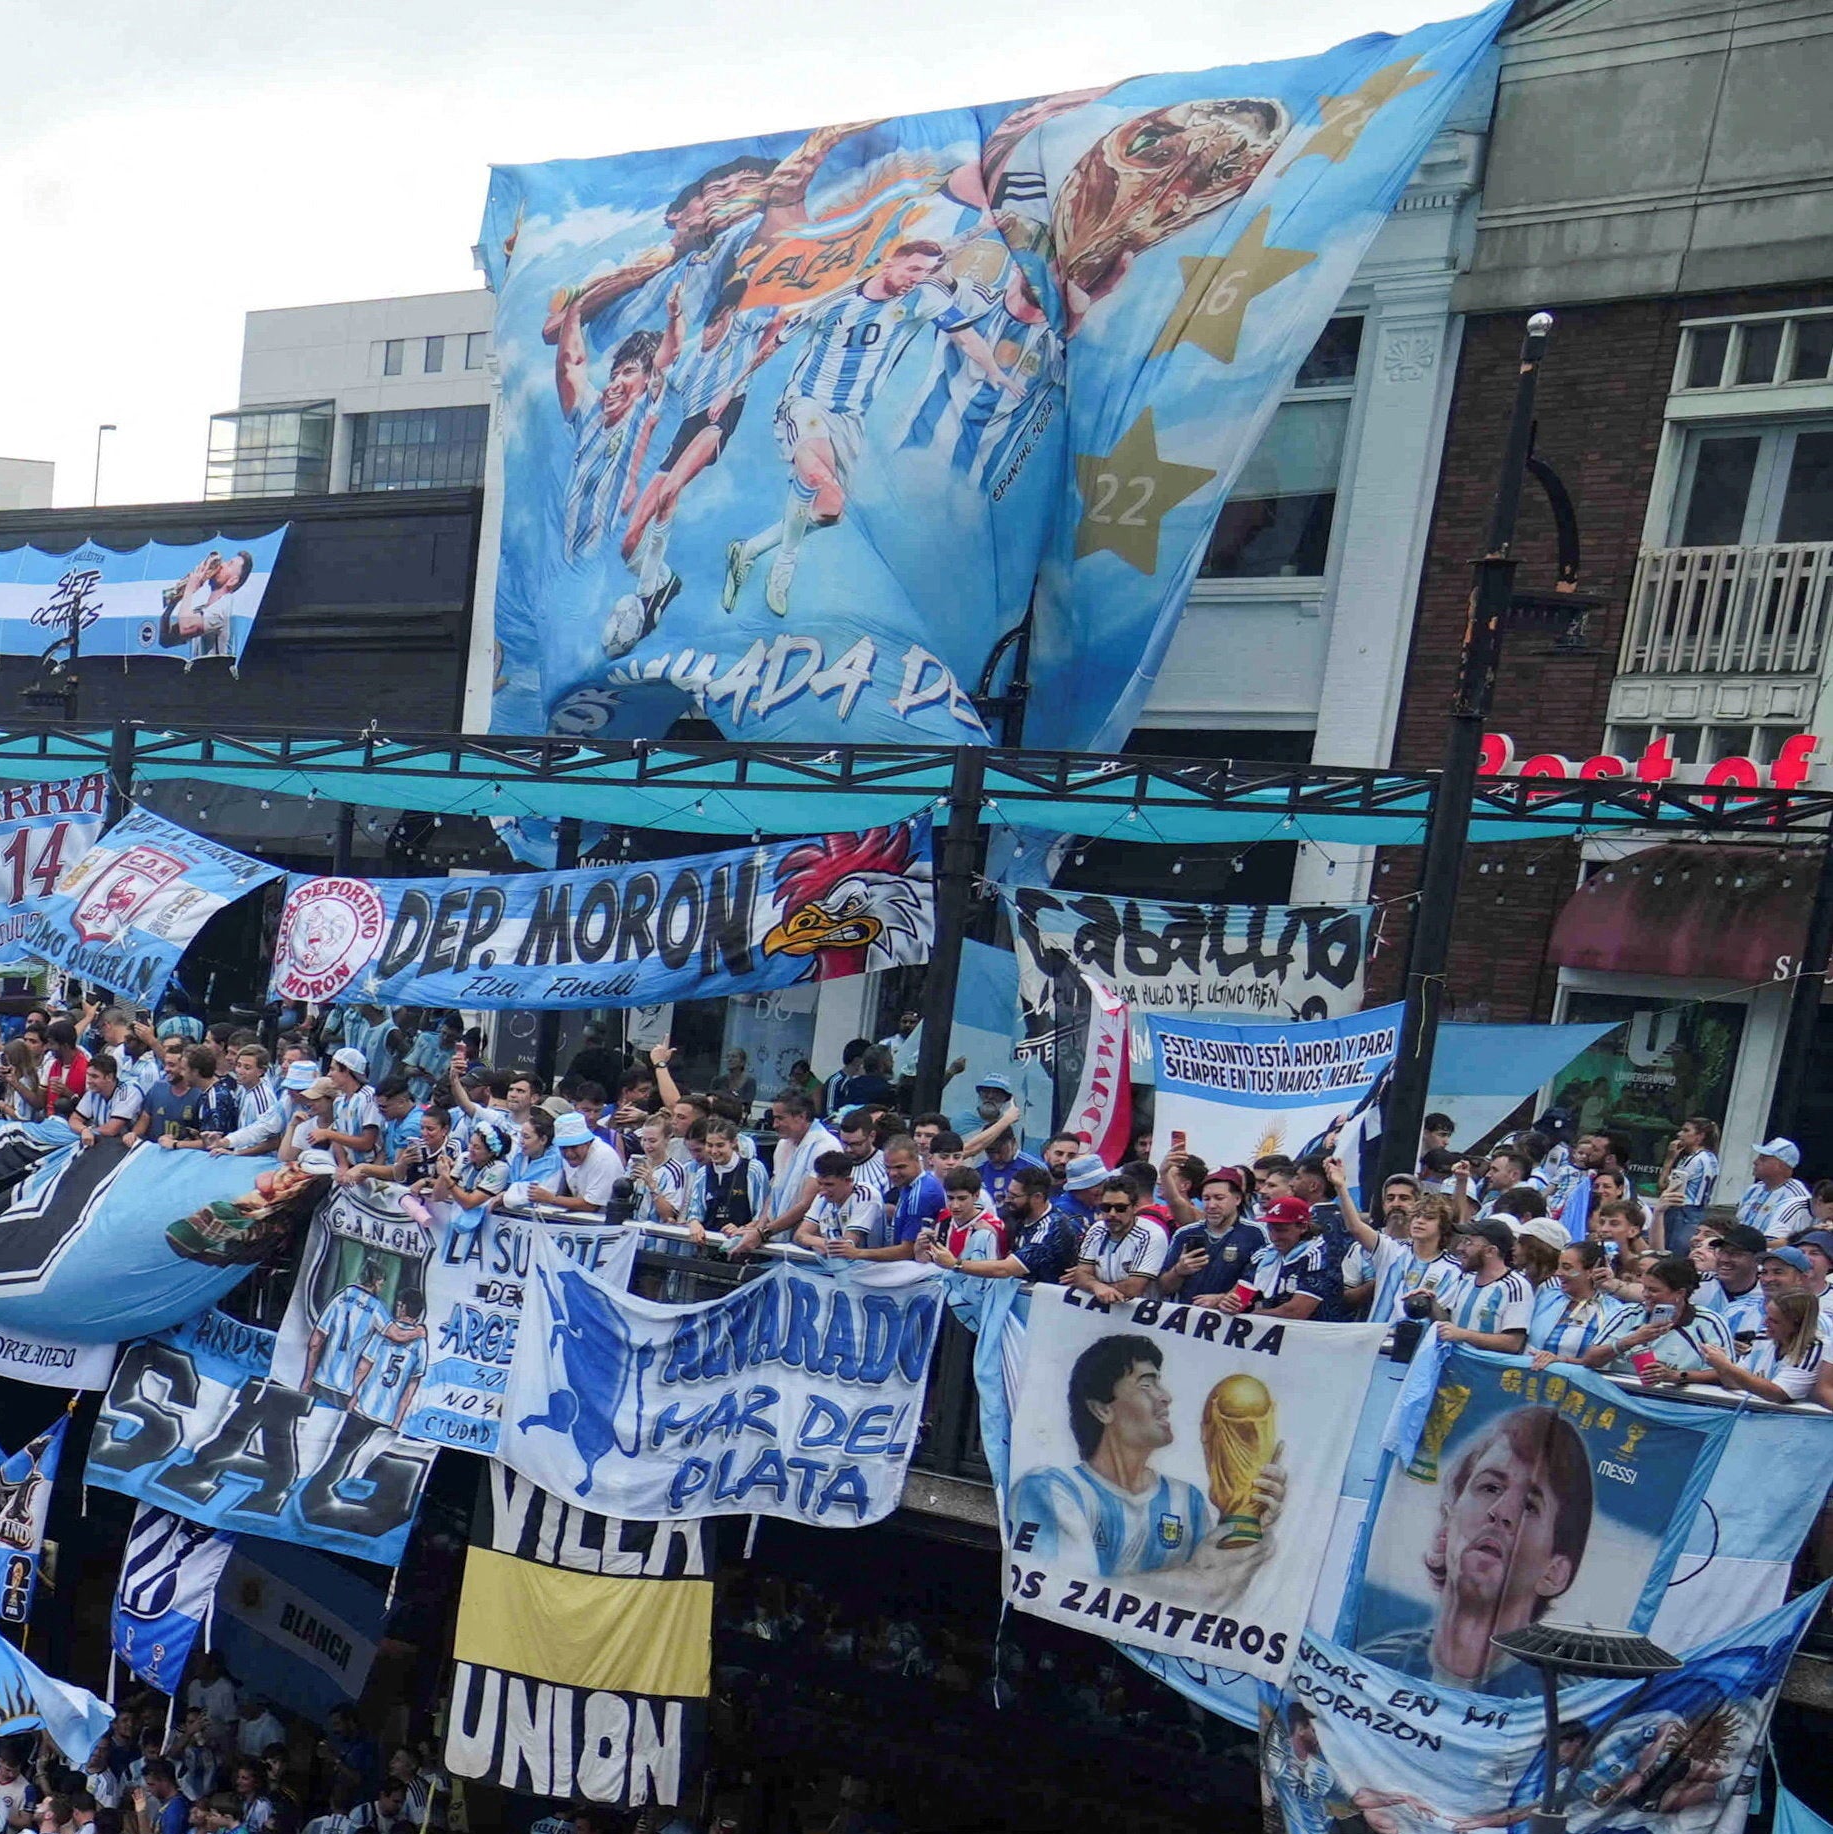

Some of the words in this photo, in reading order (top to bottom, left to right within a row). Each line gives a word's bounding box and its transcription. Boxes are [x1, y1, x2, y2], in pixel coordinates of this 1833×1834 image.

[1091, 470, 1155, 528] 22
[30, 602, 104, 631] OCTAOS
[1, 822, 70, 907] 14
[296, 877, 381, 941] DEPORTIVO
[376, 884, 507, 980] DEP.
[519, 858, 760, 976] MORON
[282, 962, 353, 1000] MORON
[1159, 1031, 1196, 1062] ESTE
[1199, 1038, 1254, 1068] ASUNTO
[1256, 1037, 1289, 1069] ESTÁ
[1294, 1039, 1341, 1068] AHORA
[1344, 1035, 1356, 1060] Y
[1357, 1027, 1394, 1056] PARA
[1164, 1058, 1227, 1092] SIEMPRE
[1230, 1064, 1247, 1092] EN
[1249, 1067, 1274, 1094] TUS
[1276, 1067, 1324, 1099] MANOS,
[663, 1275, 933, 1385] ALVARADO
[1131, 1298, 1288, 1358] BARRA
[382, 1353, 405, 1389] 5
[424, 1415, 491, 1445] CIUDAD
[652, 1382, 782, 1449] MAR
[798, 1393, 911, 1457] DEL
[668, 1448, 870, 1522] PLATA
[1596, 1459, 1638, 1486] MESSI
[278, 1604, 354, 1672] BLANCA
[1059, 1578, 1290, 1666] ZAPATEROS
[443, 1660, 684, 1808] UNION
[1293, 1672, 1444, 1755] CORAZON
[1388, 1687, 1441, 1720] EN
[1460, 1703, 1513, 1732] MI
